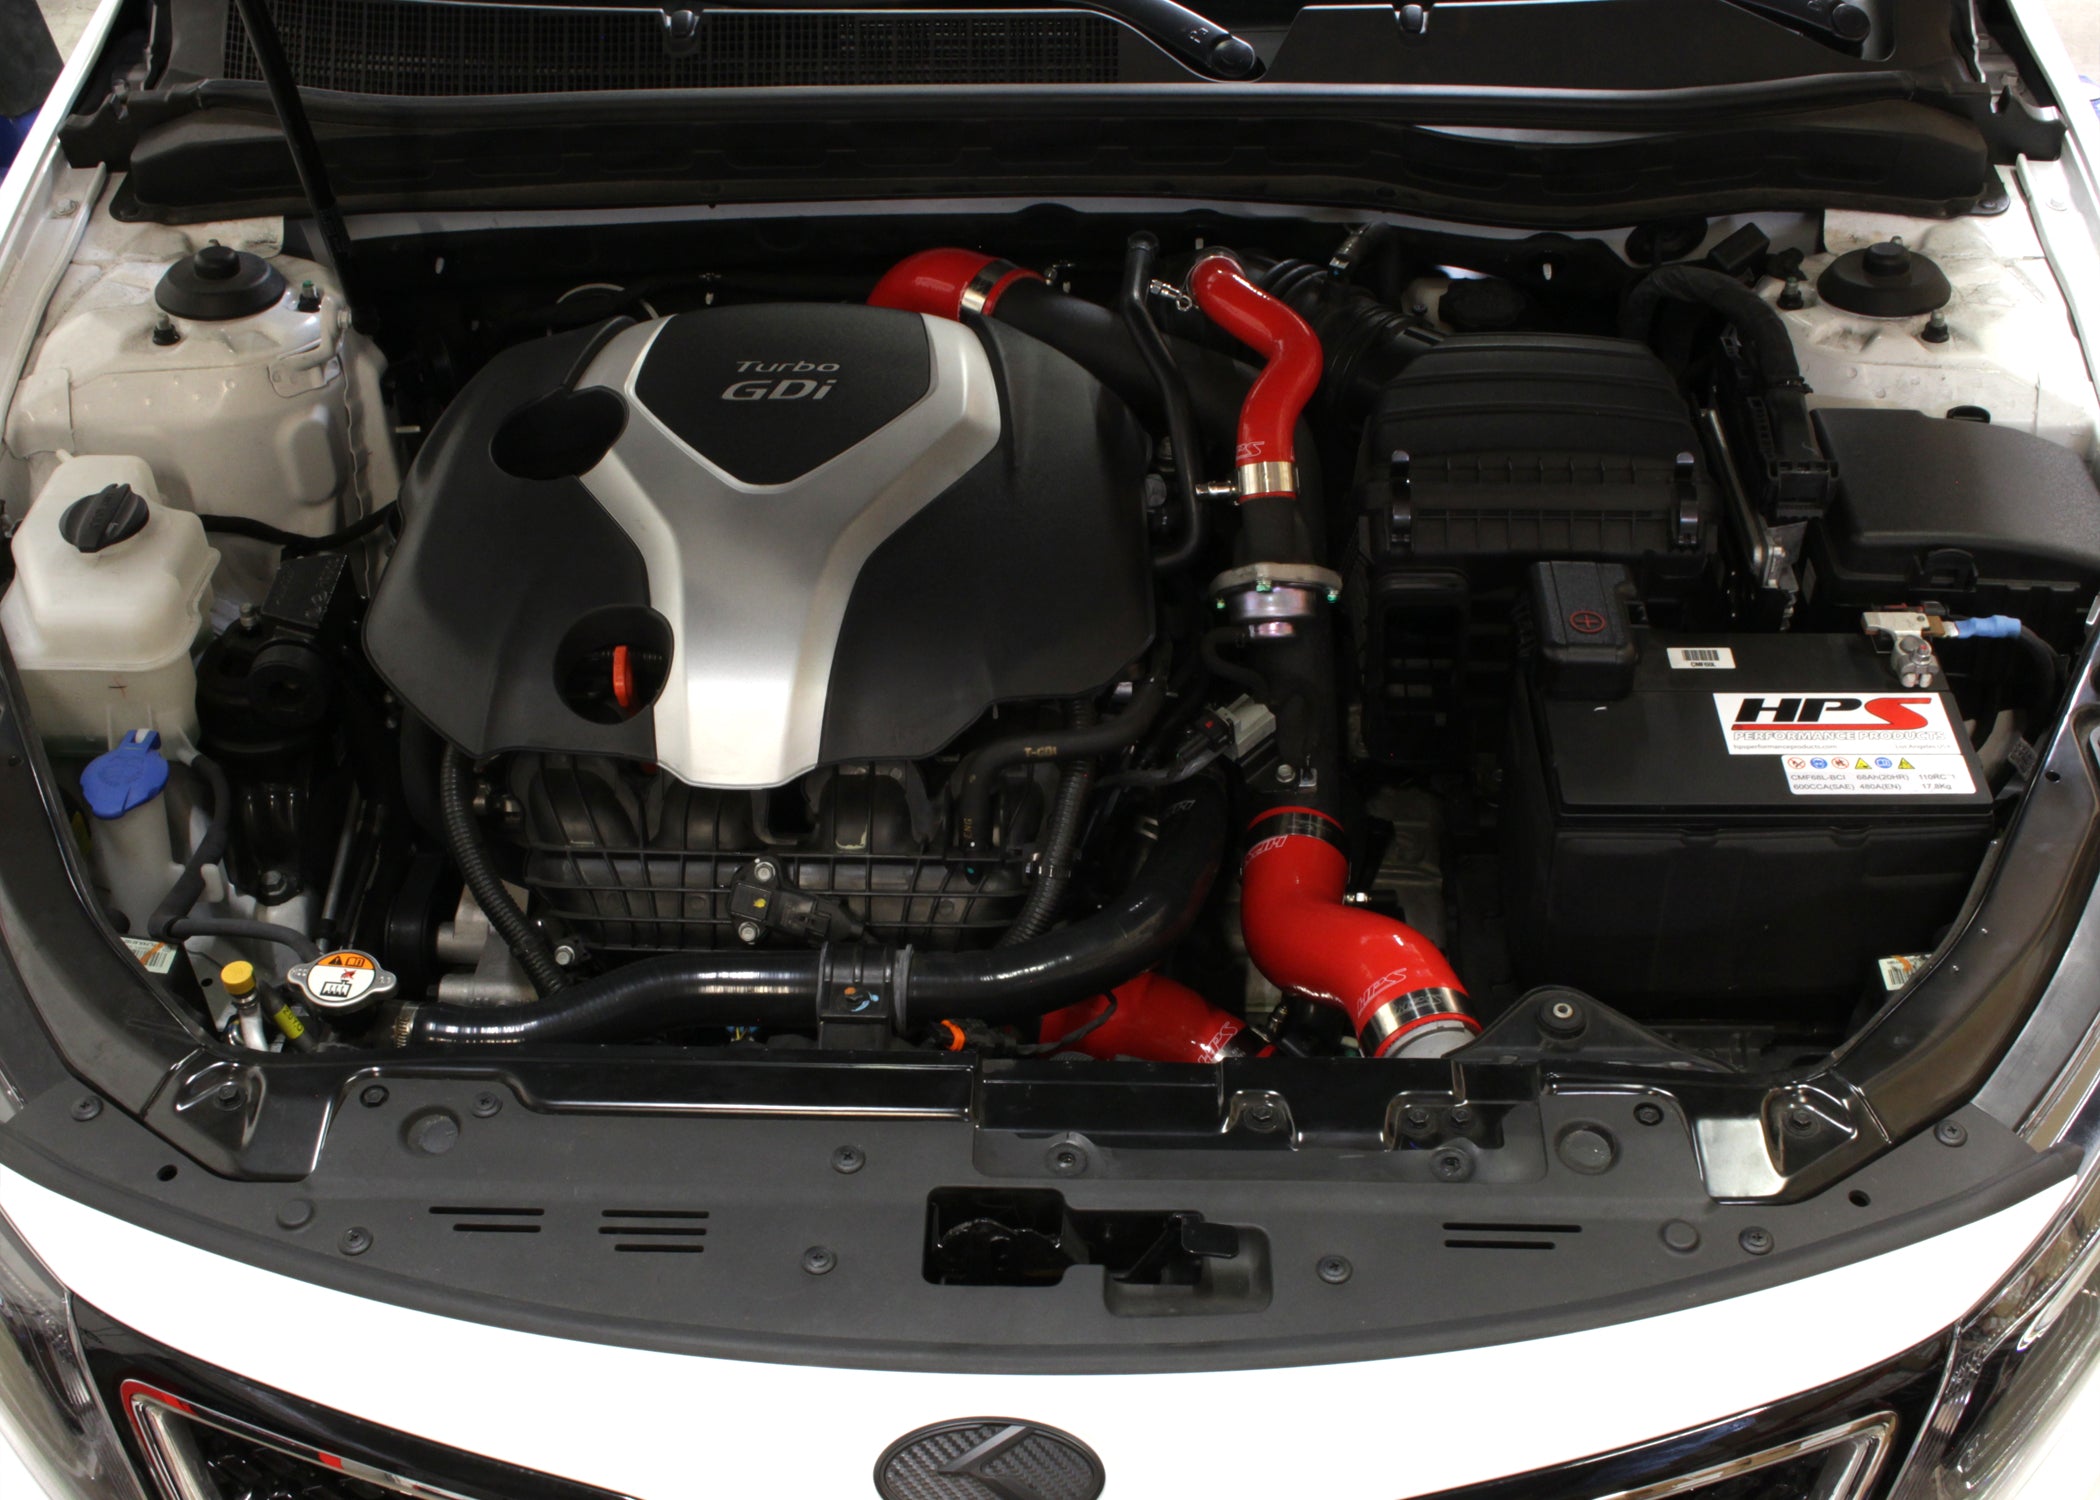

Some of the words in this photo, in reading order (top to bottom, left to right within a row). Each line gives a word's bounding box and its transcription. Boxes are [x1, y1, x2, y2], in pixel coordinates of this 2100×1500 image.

[736, 360, 841, 373] Turbo
[721, 379, 837, 401] GDi
[1732, 697, 1932, 731] HPS
[1733, 732, 1856, 741] PERFORMANCE
[1858, 732, 1947, 741] PRODUCTS
[1793, 783, 1856, 791] 600CCA(SAE)
[1859, 783, 1902, 791] 480A(EN)
[1357, 967, 1408, 1018] HPS
